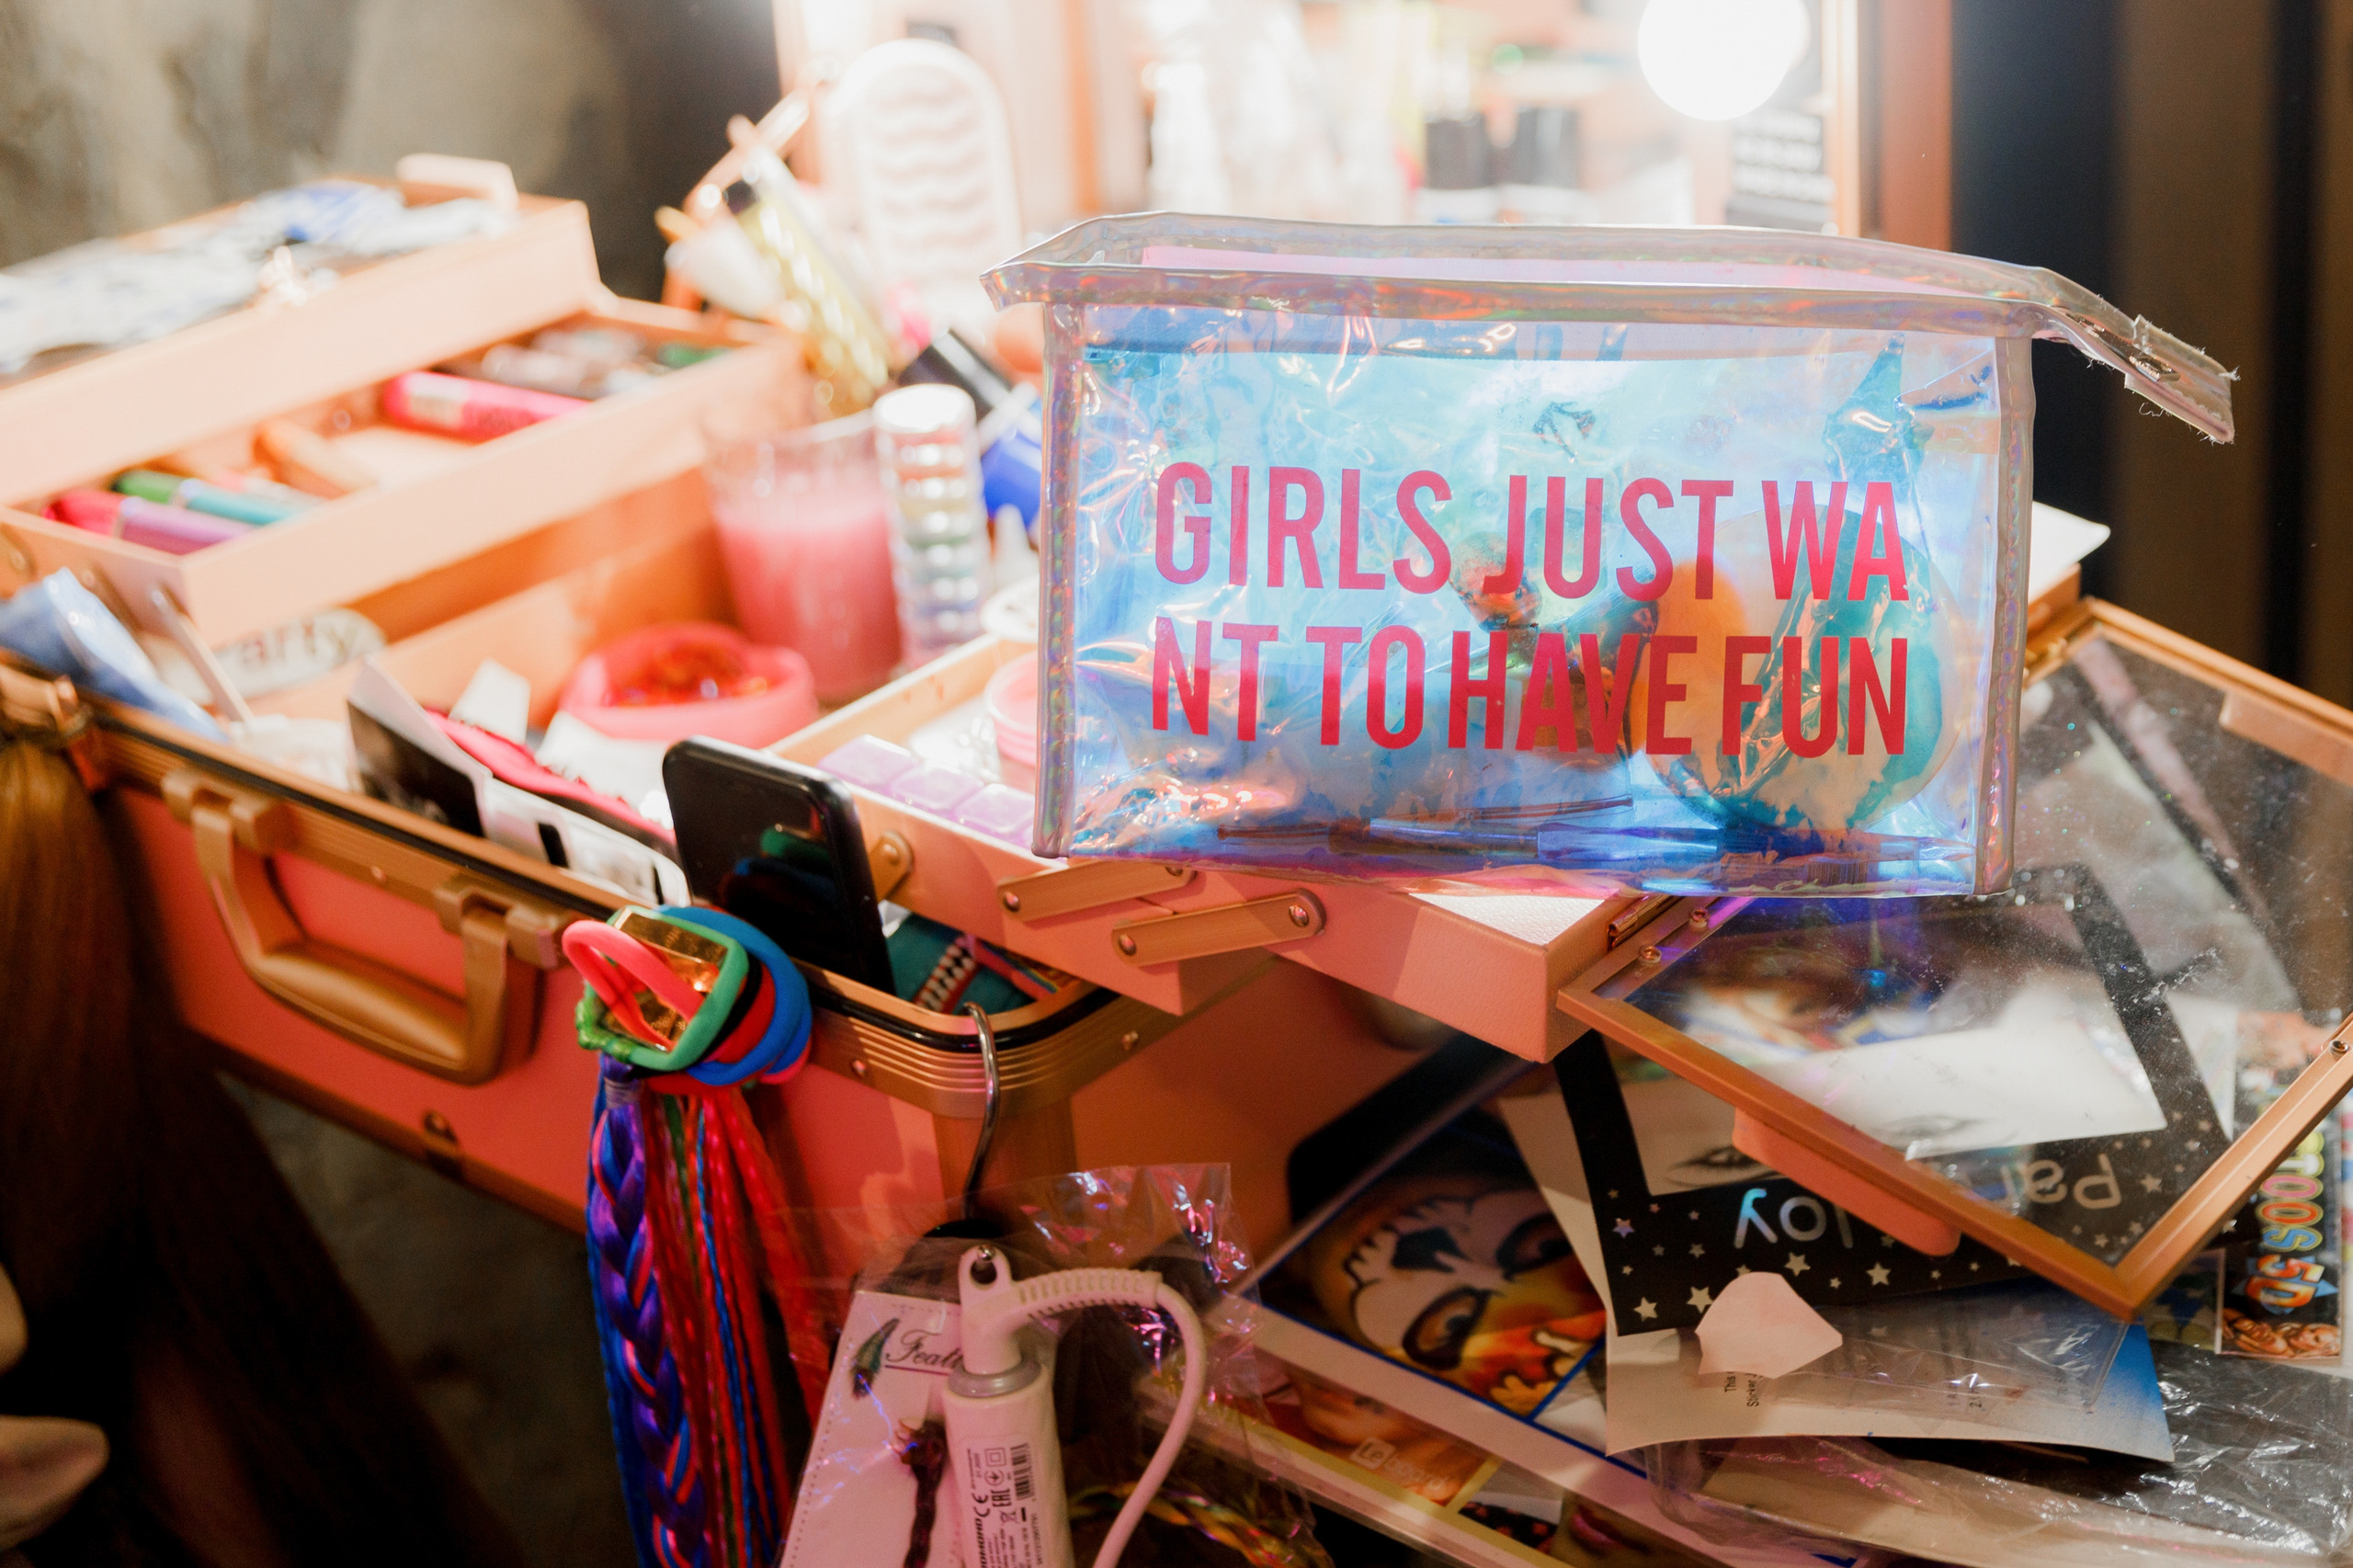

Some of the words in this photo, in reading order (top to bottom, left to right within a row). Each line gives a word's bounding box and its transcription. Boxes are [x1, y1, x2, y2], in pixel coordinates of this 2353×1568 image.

[1154, 461, 1452, 596] GIRLS
[1483, 473, 1734, 602] JUST
[1761, 480, 1910, 602] WA
[1152, 616, 1279, 742] NT
[1305, 624, 1425, 749] TO
[1448, 630, 1699, 756] HAVE
[1722, 634, 1908, 758] FUN
[2245, 1254, 2325, 1308] 5D
[1724, 1376, 1736, 1393] This
